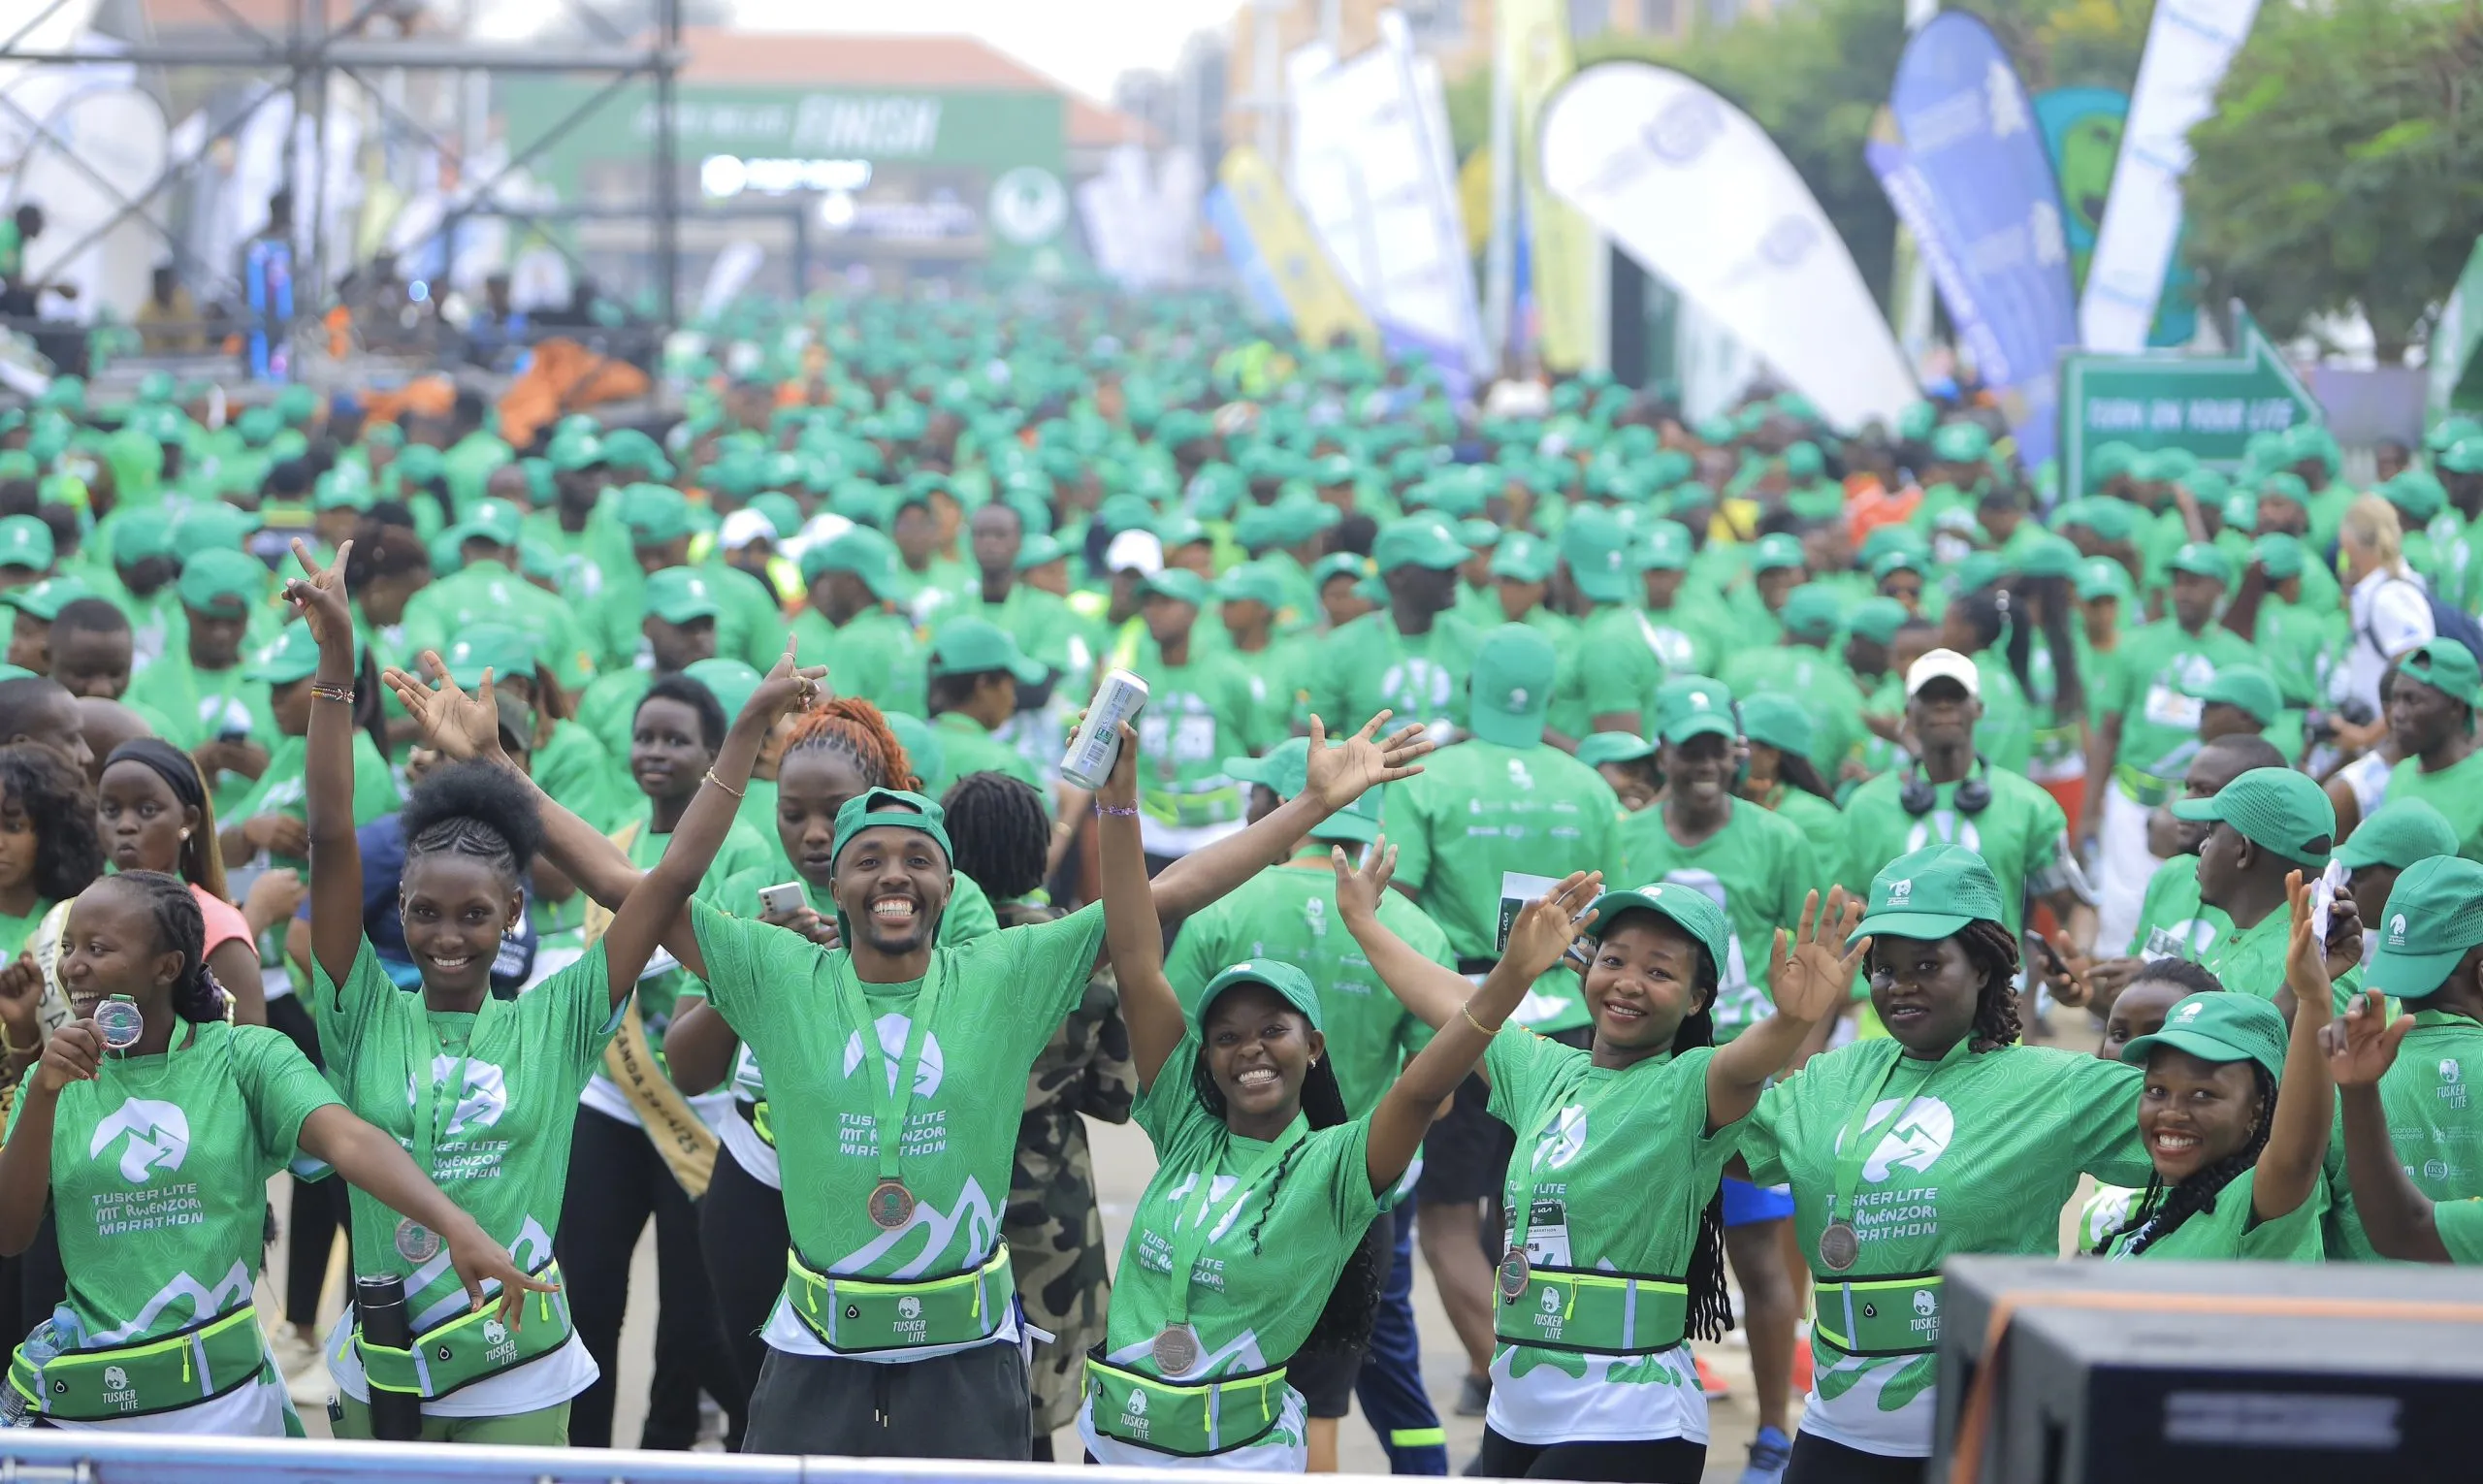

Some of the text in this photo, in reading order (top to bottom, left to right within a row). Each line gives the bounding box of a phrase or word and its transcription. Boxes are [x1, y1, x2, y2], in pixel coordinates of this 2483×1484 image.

[2087, 398, 2142, 430] TURN
[2149, 399, 2181, 430] ON
[2186, 399, 2244, 431] YOUR
[2436, 1084, 2467, 1099] TUSKER
[2450, 1095, 2467, 1110] LITE
[912, 1110, 947, 1126] LITE
[839, 1127, 865, 1143] MT
[470, 1140, 509, 1152] LITE
[839, 1139, 947, 1157] MARTHON
[92, 1182, 198, 1206] TUSKER LITE
[1539, 1183, 1566, 1195] LITE
[1896, 1186, 1938, 1203] LITE
[96, 1197, 202, 1222] MT RWENZORI
[1856, 1205, 1938, 1226] RWENZORI
[99, 1211, 204, 1236] MARATHON
[1139, 1242, 1157, 1260] MT
[892, 1319, 926, 1333] TUSKER
[1533, 1312, 1564, 1328] TUSKER
[908, 1330, 927, 1343] LITE
[1544, 1327, 1564, 1339] LITE
[1926, 1329, 1940, 1341] LIT
[485, 1339, 515, 1363] TUSKER
[501, 1349, 518, 1366] LITE
[102, 1389, 136, 1404] TUSKER
[120, 1399, 139, 1411] LITE
[1120, 1412, 1149, 1430] TUSKER
[1133, 1428, 1150, 1440] LITE
